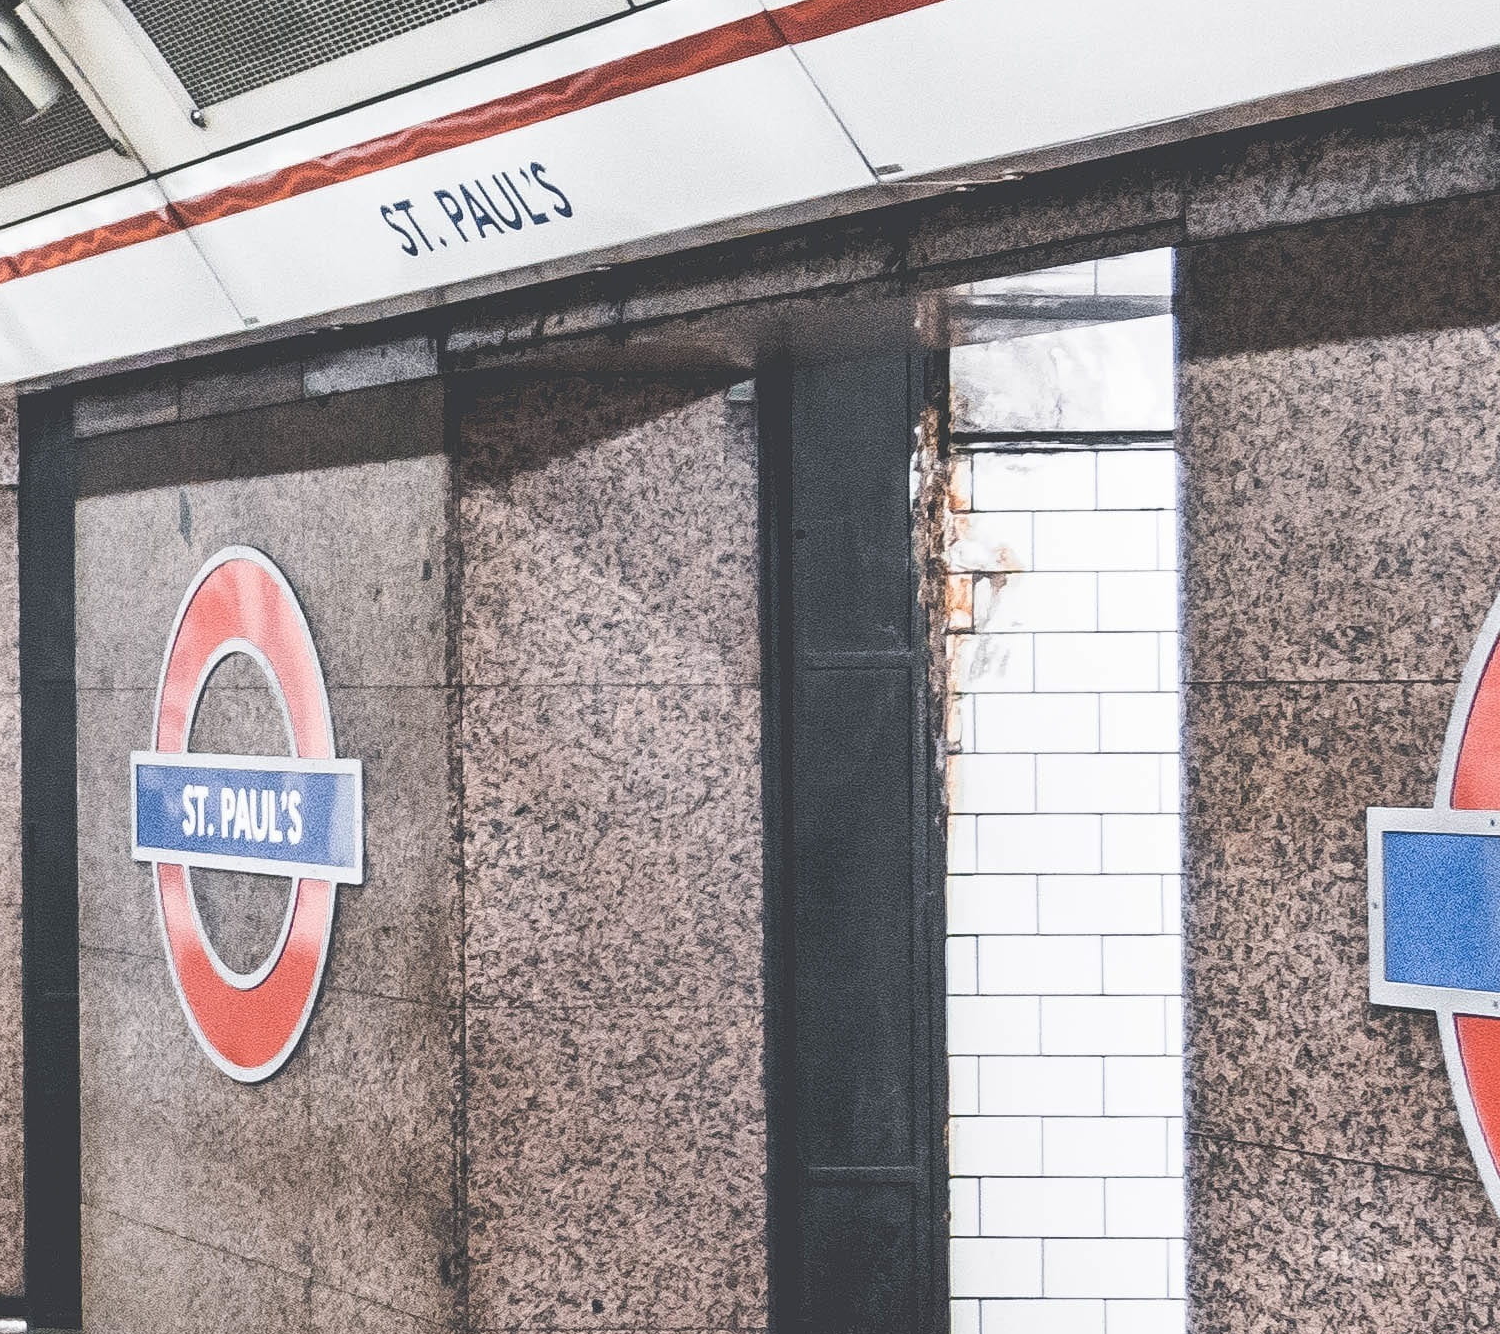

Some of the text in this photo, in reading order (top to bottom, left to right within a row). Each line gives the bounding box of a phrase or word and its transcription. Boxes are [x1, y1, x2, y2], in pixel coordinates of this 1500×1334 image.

[380, 162, 573, 256] ST. PAUL'S
[181, 787, 304, 845] ST. PAUL'S
